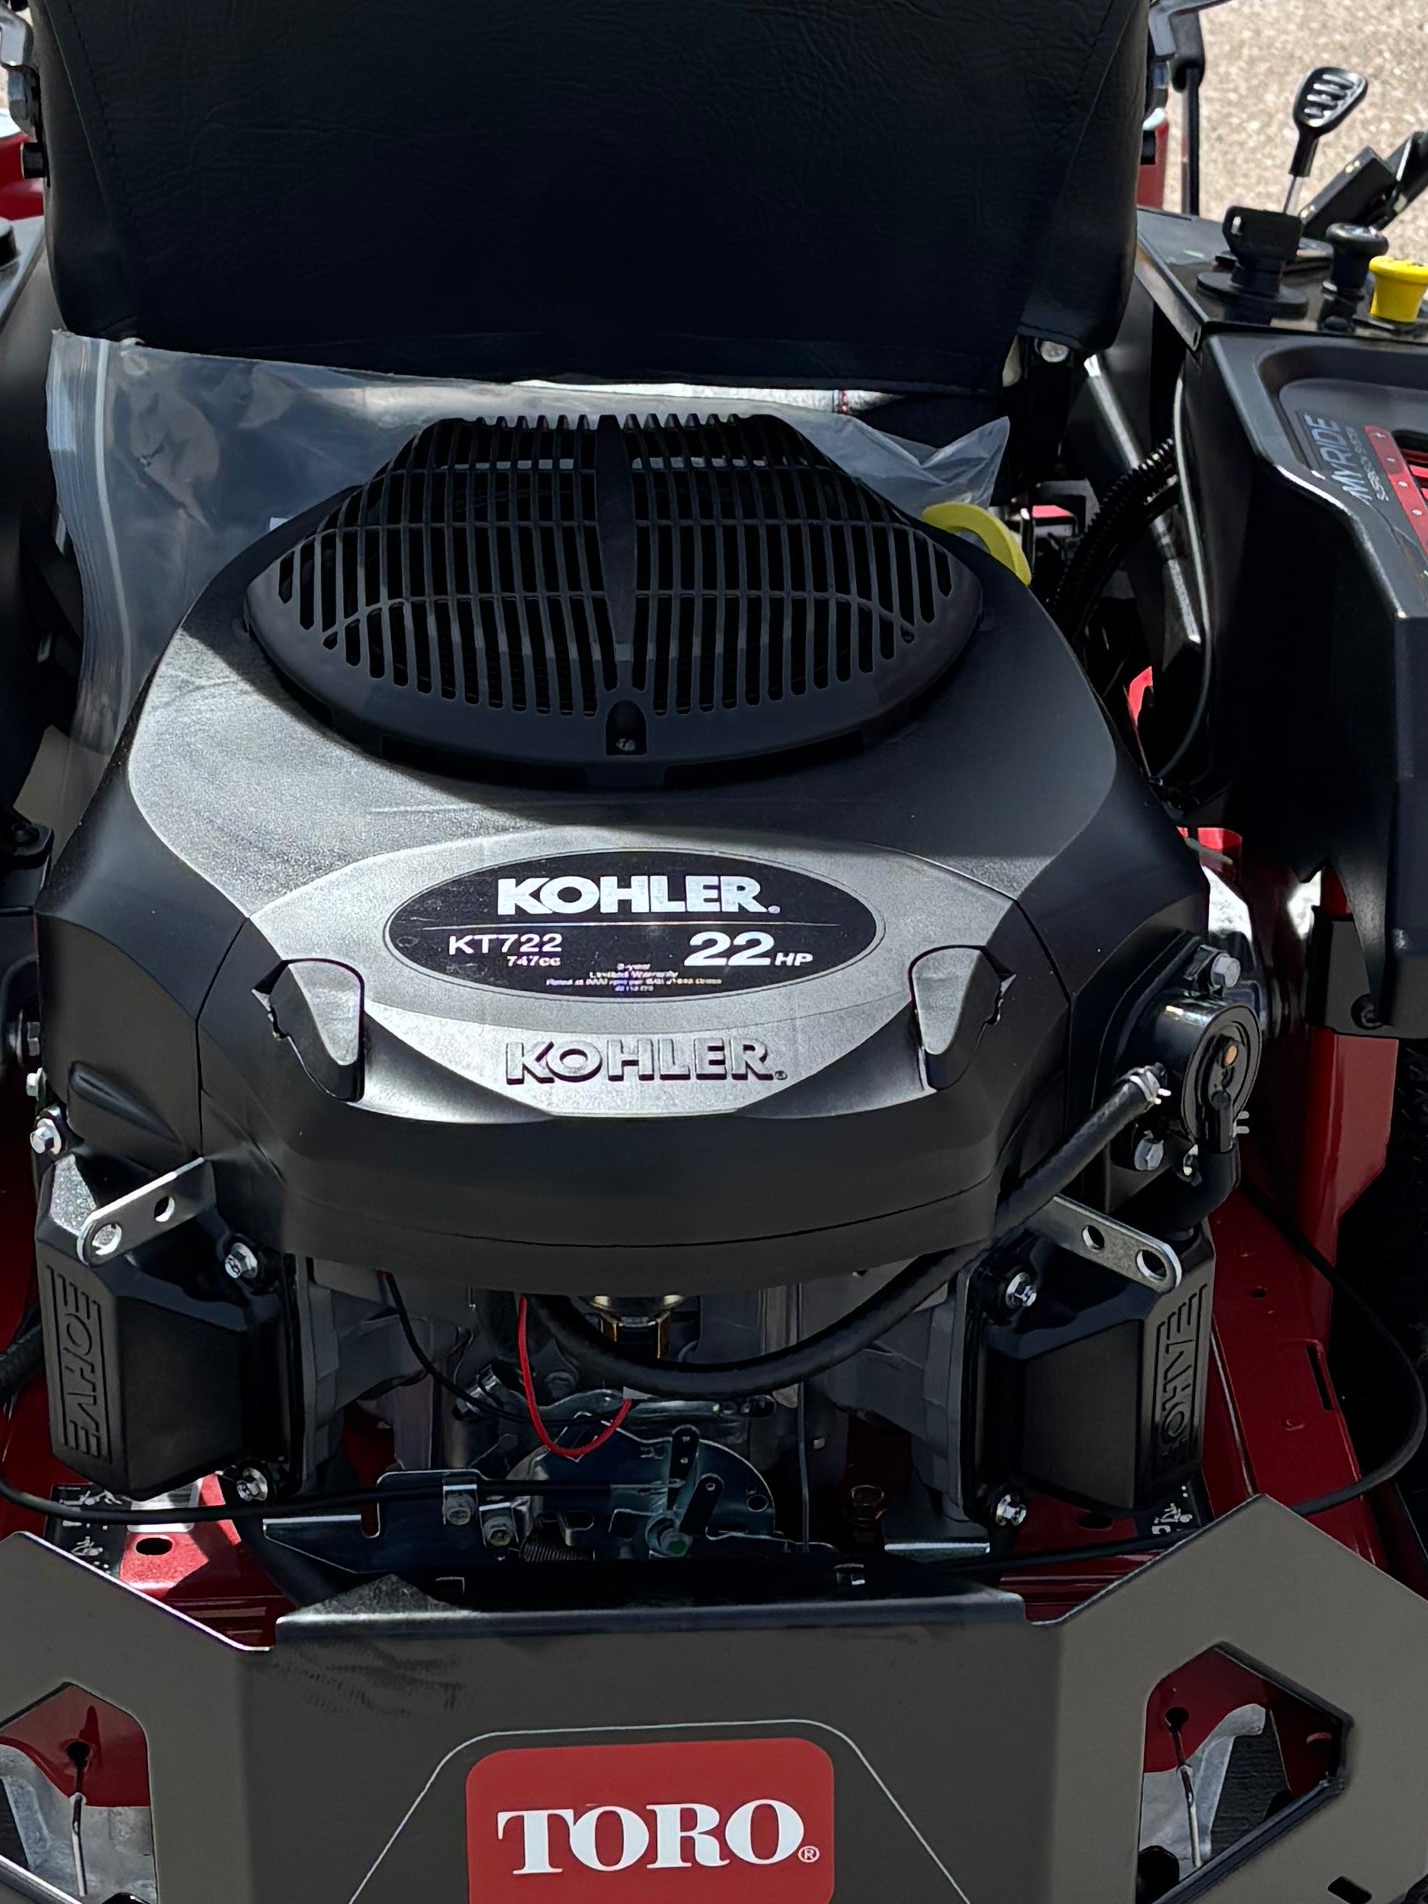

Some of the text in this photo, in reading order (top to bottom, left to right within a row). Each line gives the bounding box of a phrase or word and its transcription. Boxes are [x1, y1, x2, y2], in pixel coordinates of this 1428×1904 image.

[448, 931, 814, 967] KT722 22 HP
[506, 954, 561, 968] 747cc
[505, 1036, 788, 1086] KOHLER
[497, 1798, 820, 1876] TORO
